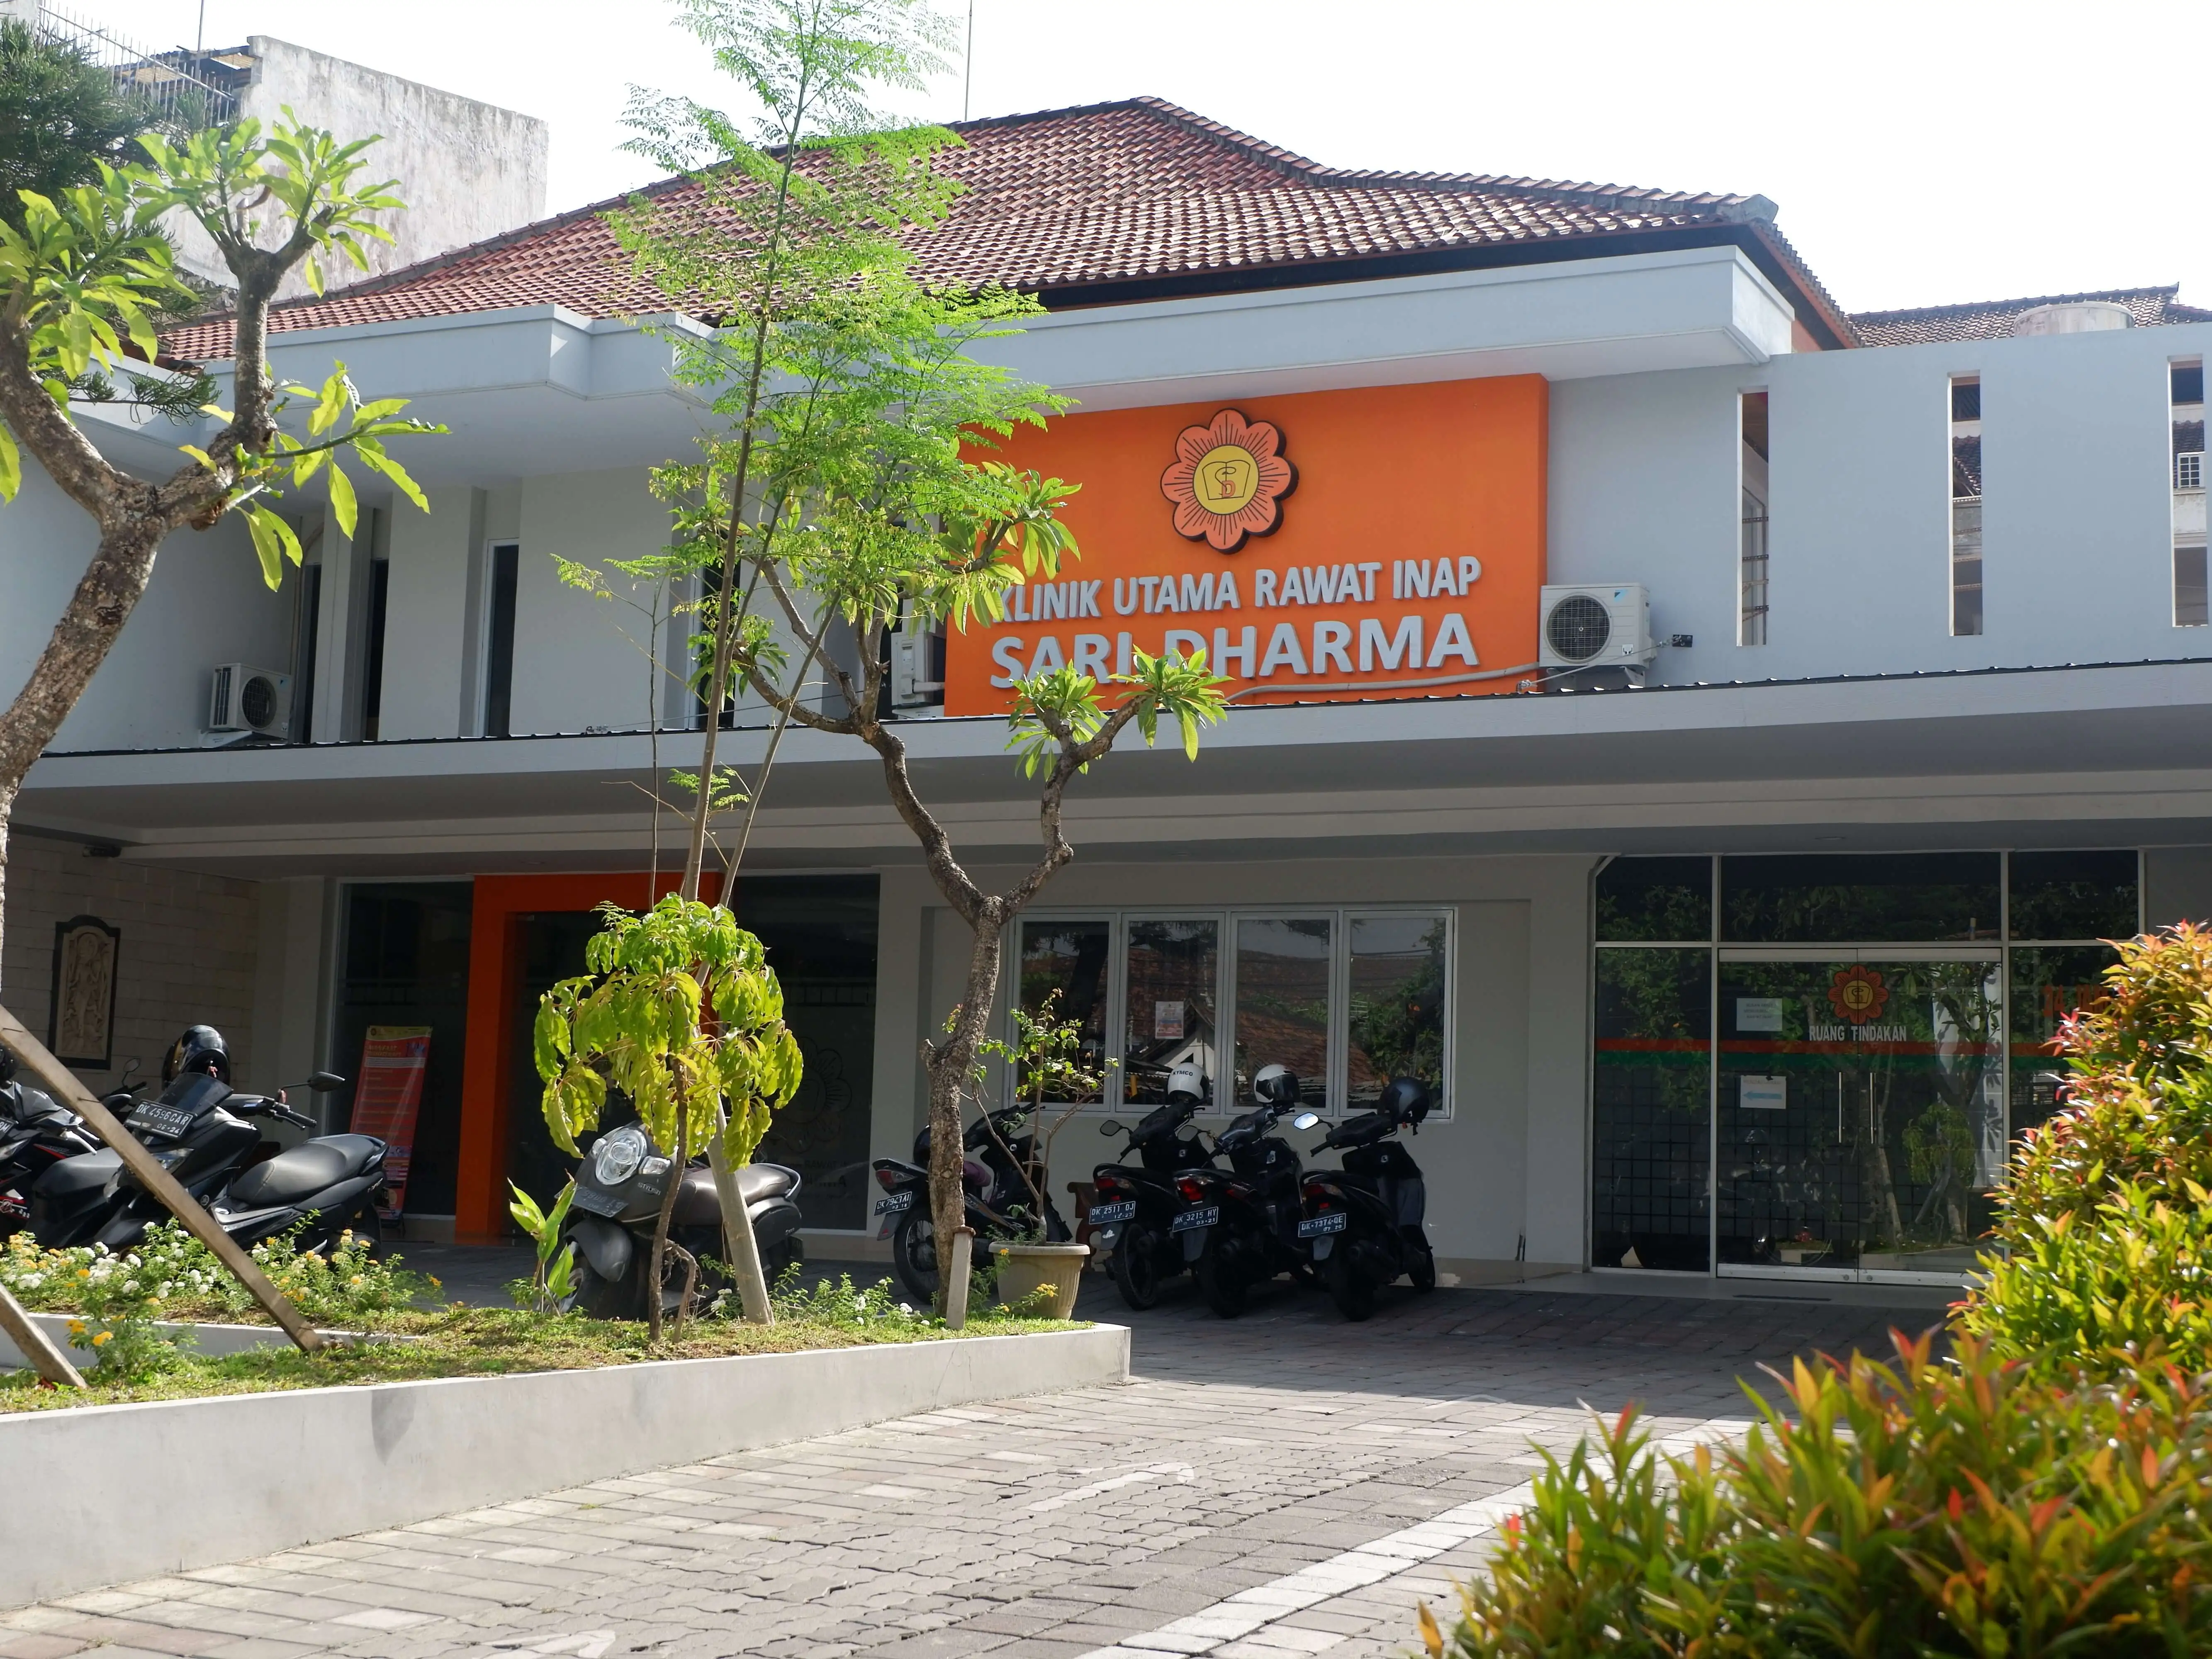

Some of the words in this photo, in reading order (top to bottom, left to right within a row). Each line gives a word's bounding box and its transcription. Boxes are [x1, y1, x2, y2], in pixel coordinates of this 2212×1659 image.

[1114, 571, 1240, 615] UTAMA
[1255, 562, 1382, 608] RAWAT
[1393, 555, 1482, 599] INAP
[990, 632, 1132, 689] SARI
[1165, 613, 1480, 682] DHARMA
[1809, 1025, 1845, 1041] RUANG
[1851, 1026, 1907, 1041] TINDAKAN
[136, 1104, 150, 1114] DK
[877, 1200, 886, 1209] DK
[1104, 1205, 1120, 1214] 2511
[1175, 1216, 1184, 1224] DK
[1187, 1211, 1204, 1221] 3215
[1208, 1208, 1217, 1217] HY
